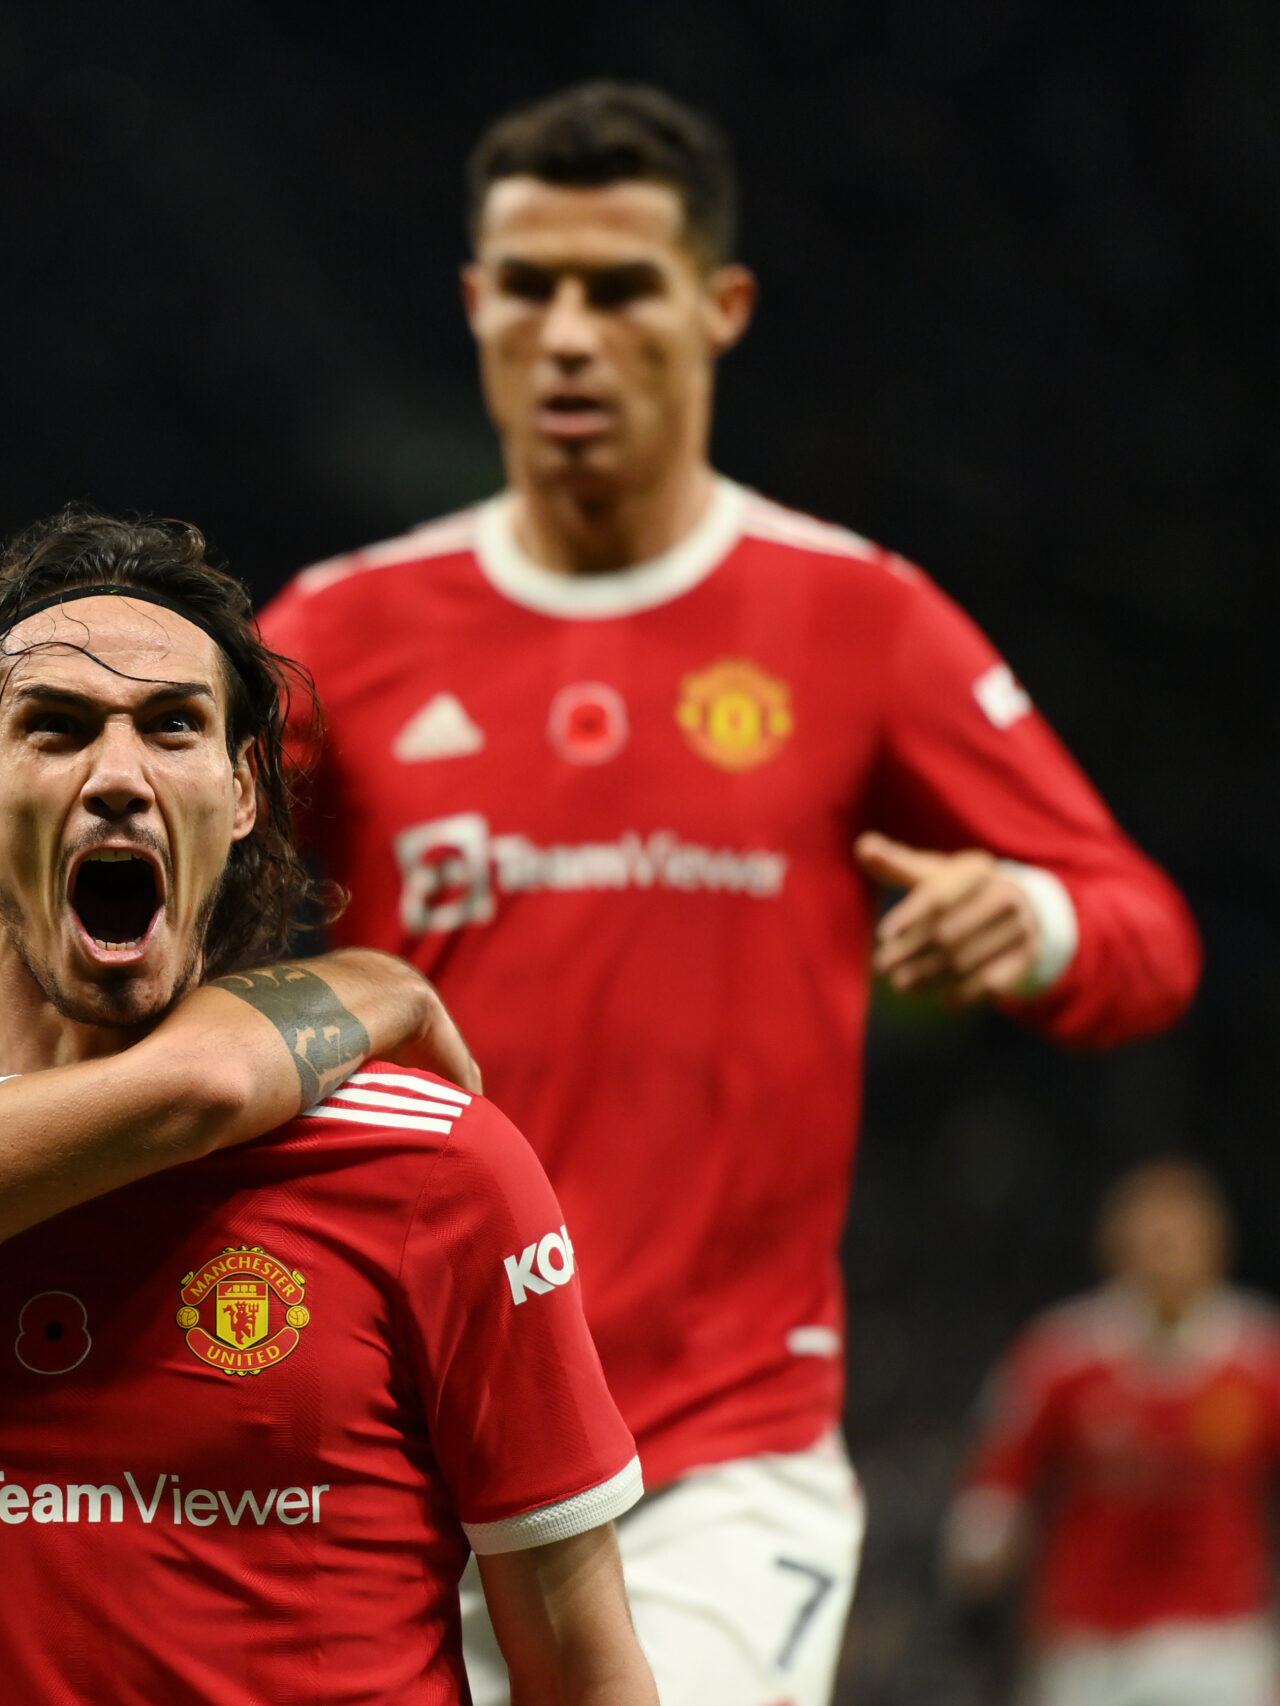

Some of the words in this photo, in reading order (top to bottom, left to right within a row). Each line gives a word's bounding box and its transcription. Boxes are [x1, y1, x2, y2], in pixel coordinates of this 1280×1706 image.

[190, 1256, 296, 1297] MANCHESTER
[207, 1345, 280, 1367] UNITED
[774, 1557, 834, 1669] 7
